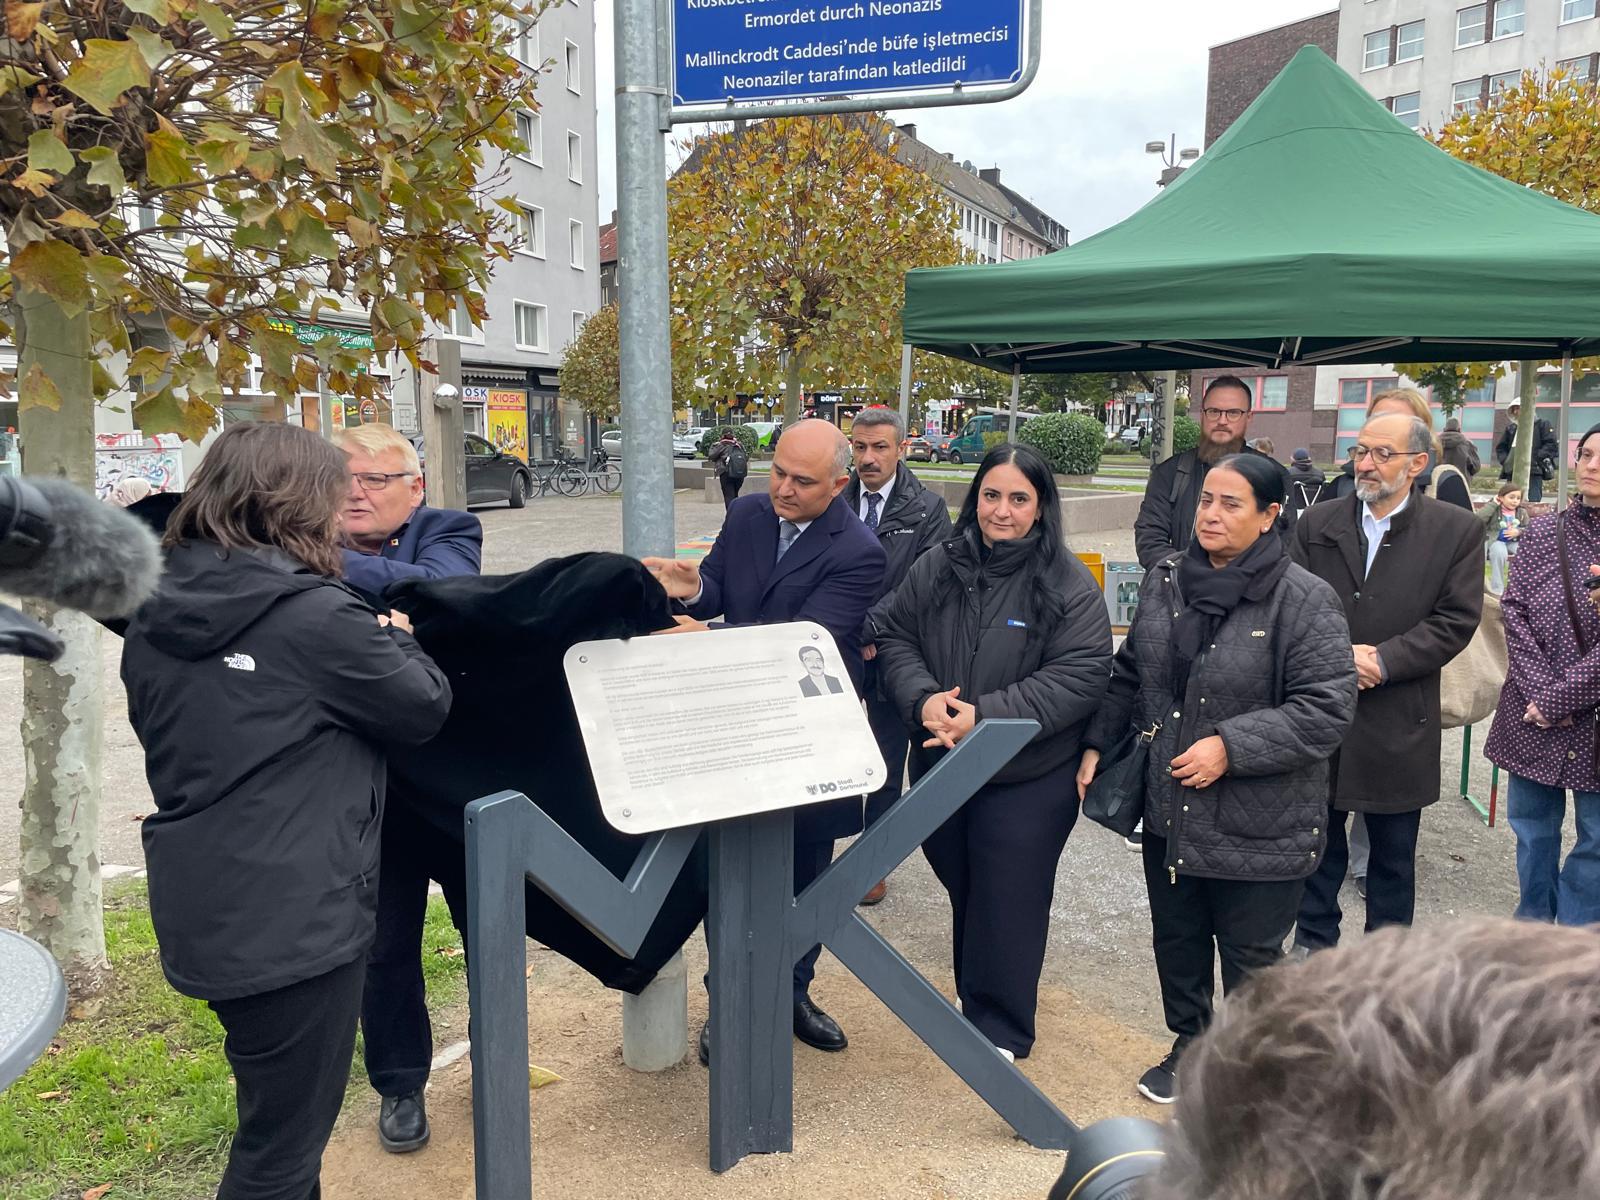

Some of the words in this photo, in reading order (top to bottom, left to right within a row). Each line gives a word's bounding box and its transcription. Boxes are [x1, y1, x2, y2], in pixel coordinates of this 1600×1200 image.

[745, 9, 816, 29] Ermordet
[820, 4, 864, 21] durch
[869, 0, 942, 17] Neonazis
[685, 46, 779, 68] Mallinckrodt
[882, 34, 919, 52] büfe
[923, 25, 1009, 51] işletmecisi
[723, 71, 804, 90] Neonaziler
[808, 64, 888, 84] tarafından
[893, 56, 966, 77] katledildi
[465, 388, 487, 397] OSK
[492, 394, 521, 403] KIOSK
[819, 782, 837, 794] DO
